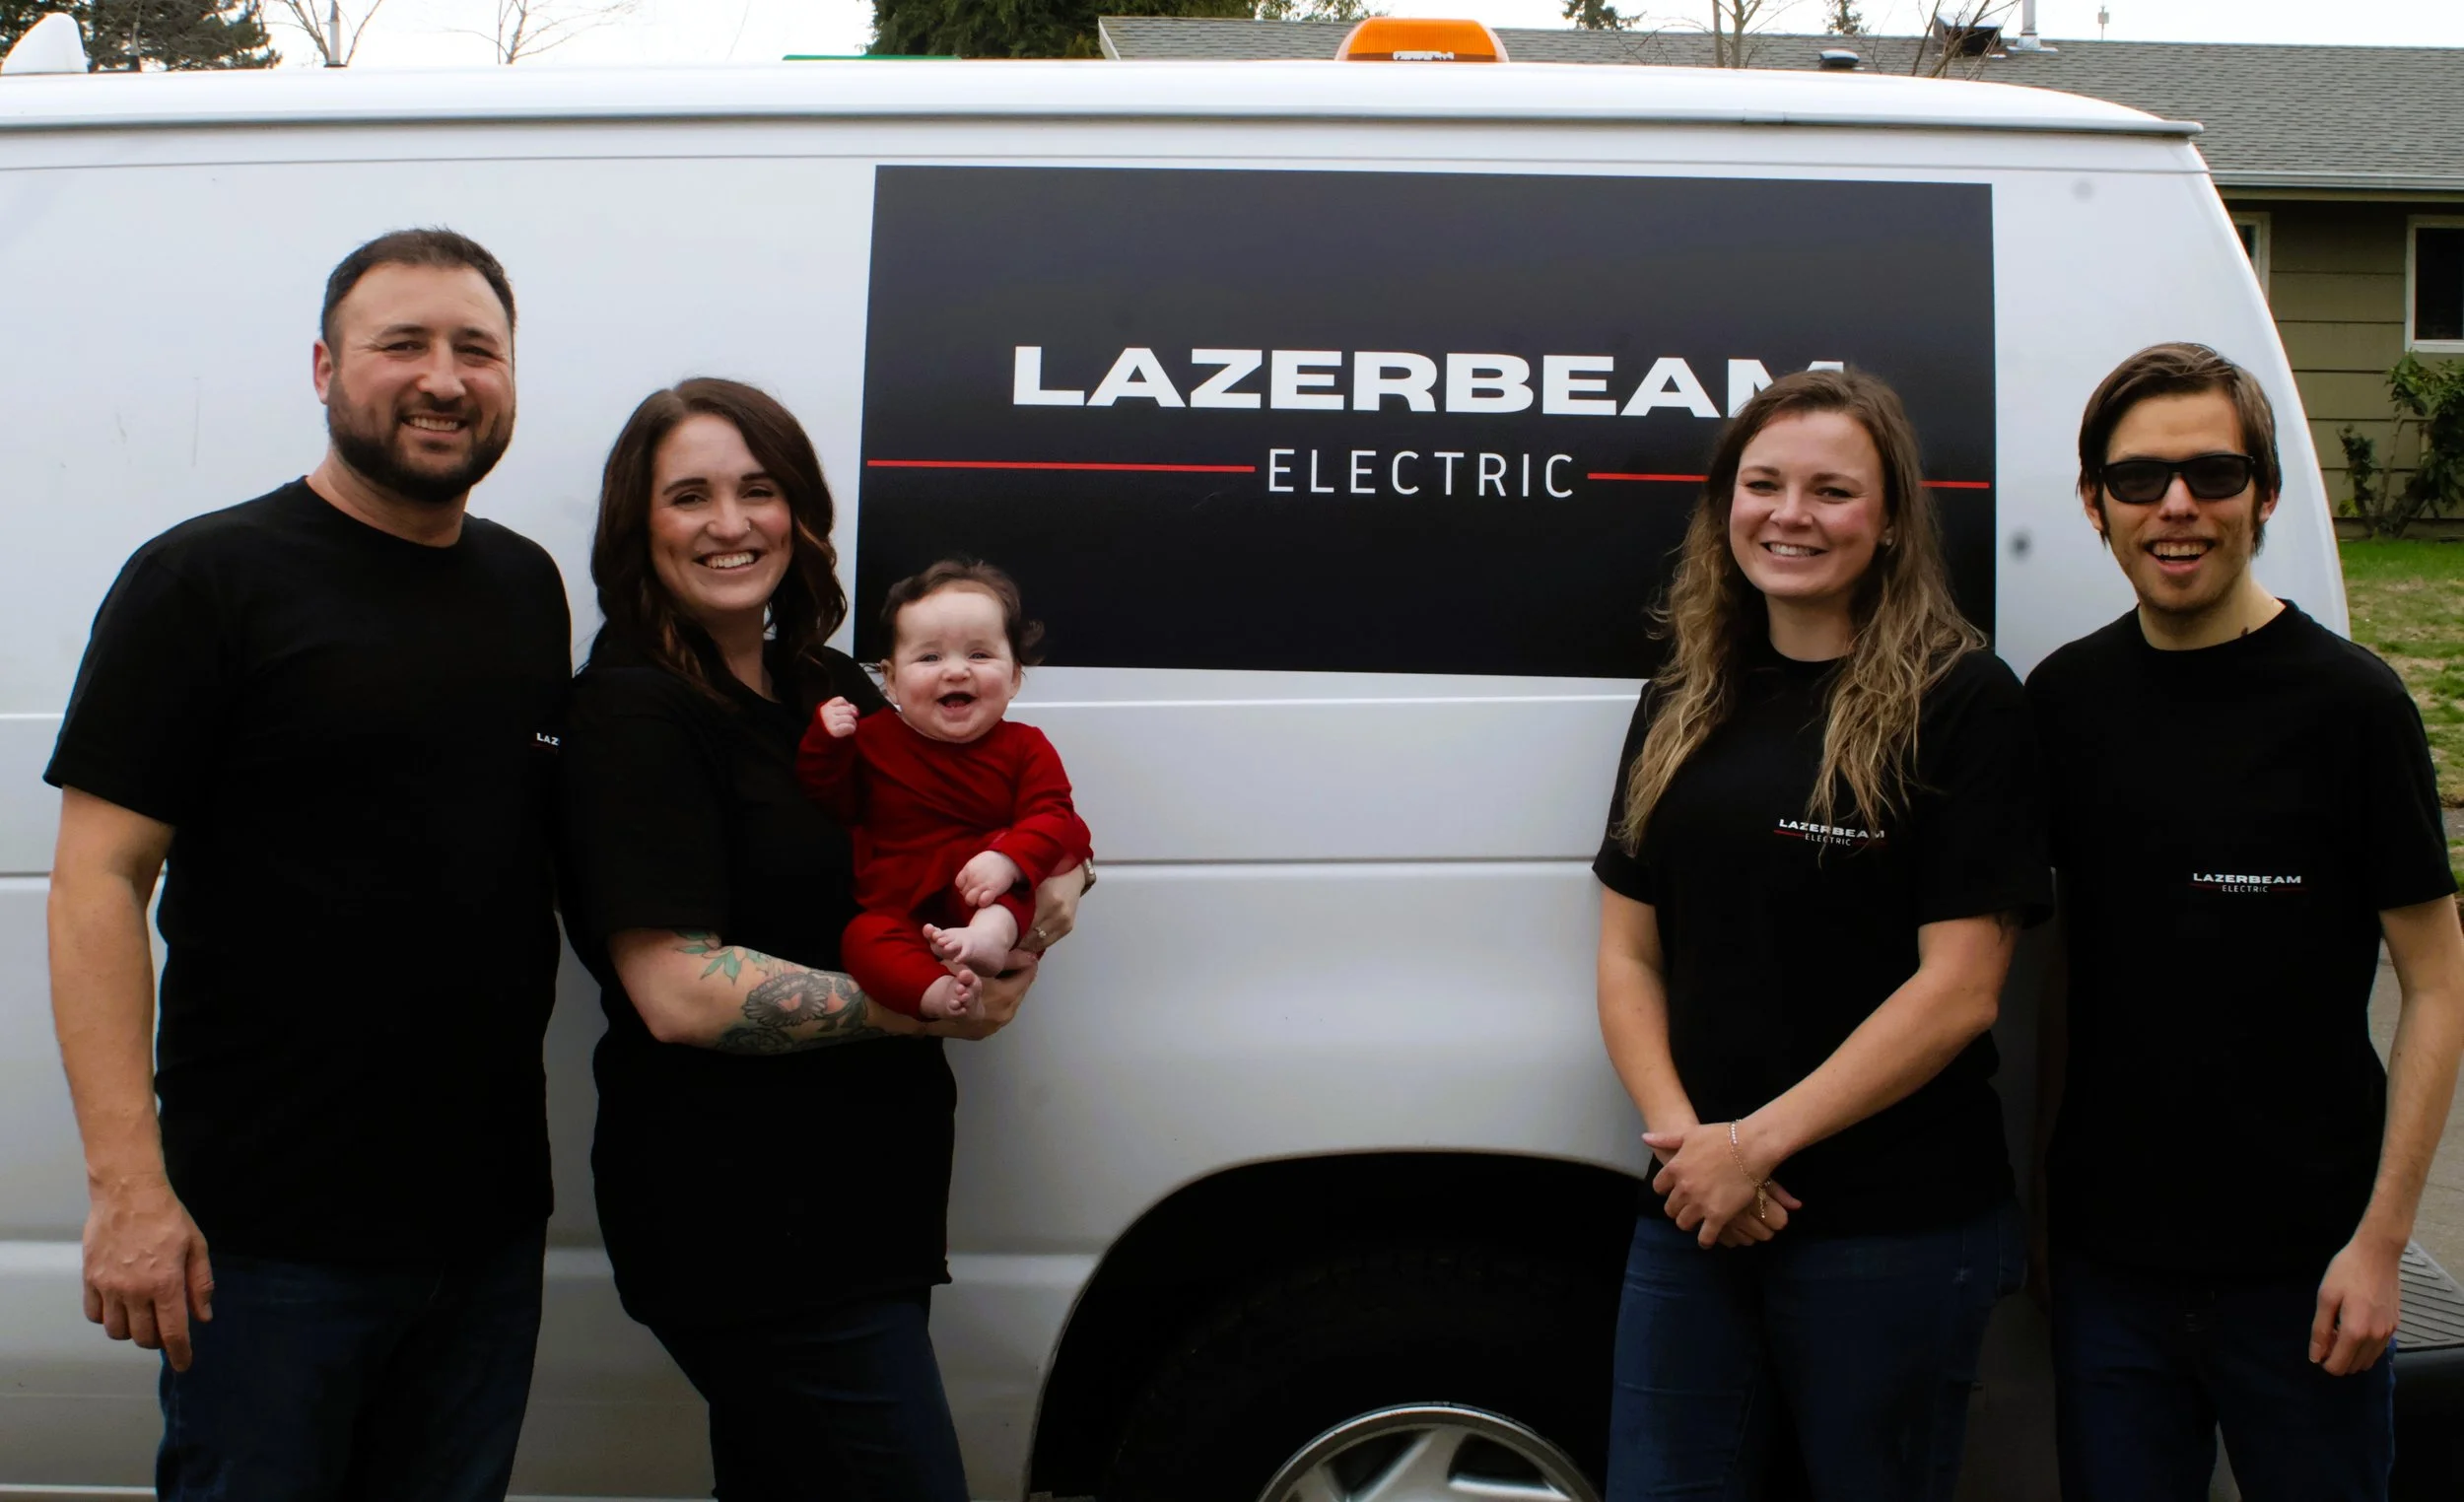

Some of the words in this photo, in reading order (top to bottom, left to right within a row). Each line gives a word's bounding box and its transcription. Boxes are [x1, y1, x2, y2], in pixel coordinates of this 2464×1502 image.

[1268, 448, 1574, 498] ELECTRIC
[1805, 833, 1851, 847] ELECTRIC
[2193, 872, 2301, 884] LAZERBEAM
[2222, 884, 2269, 893] ELECTRIC
